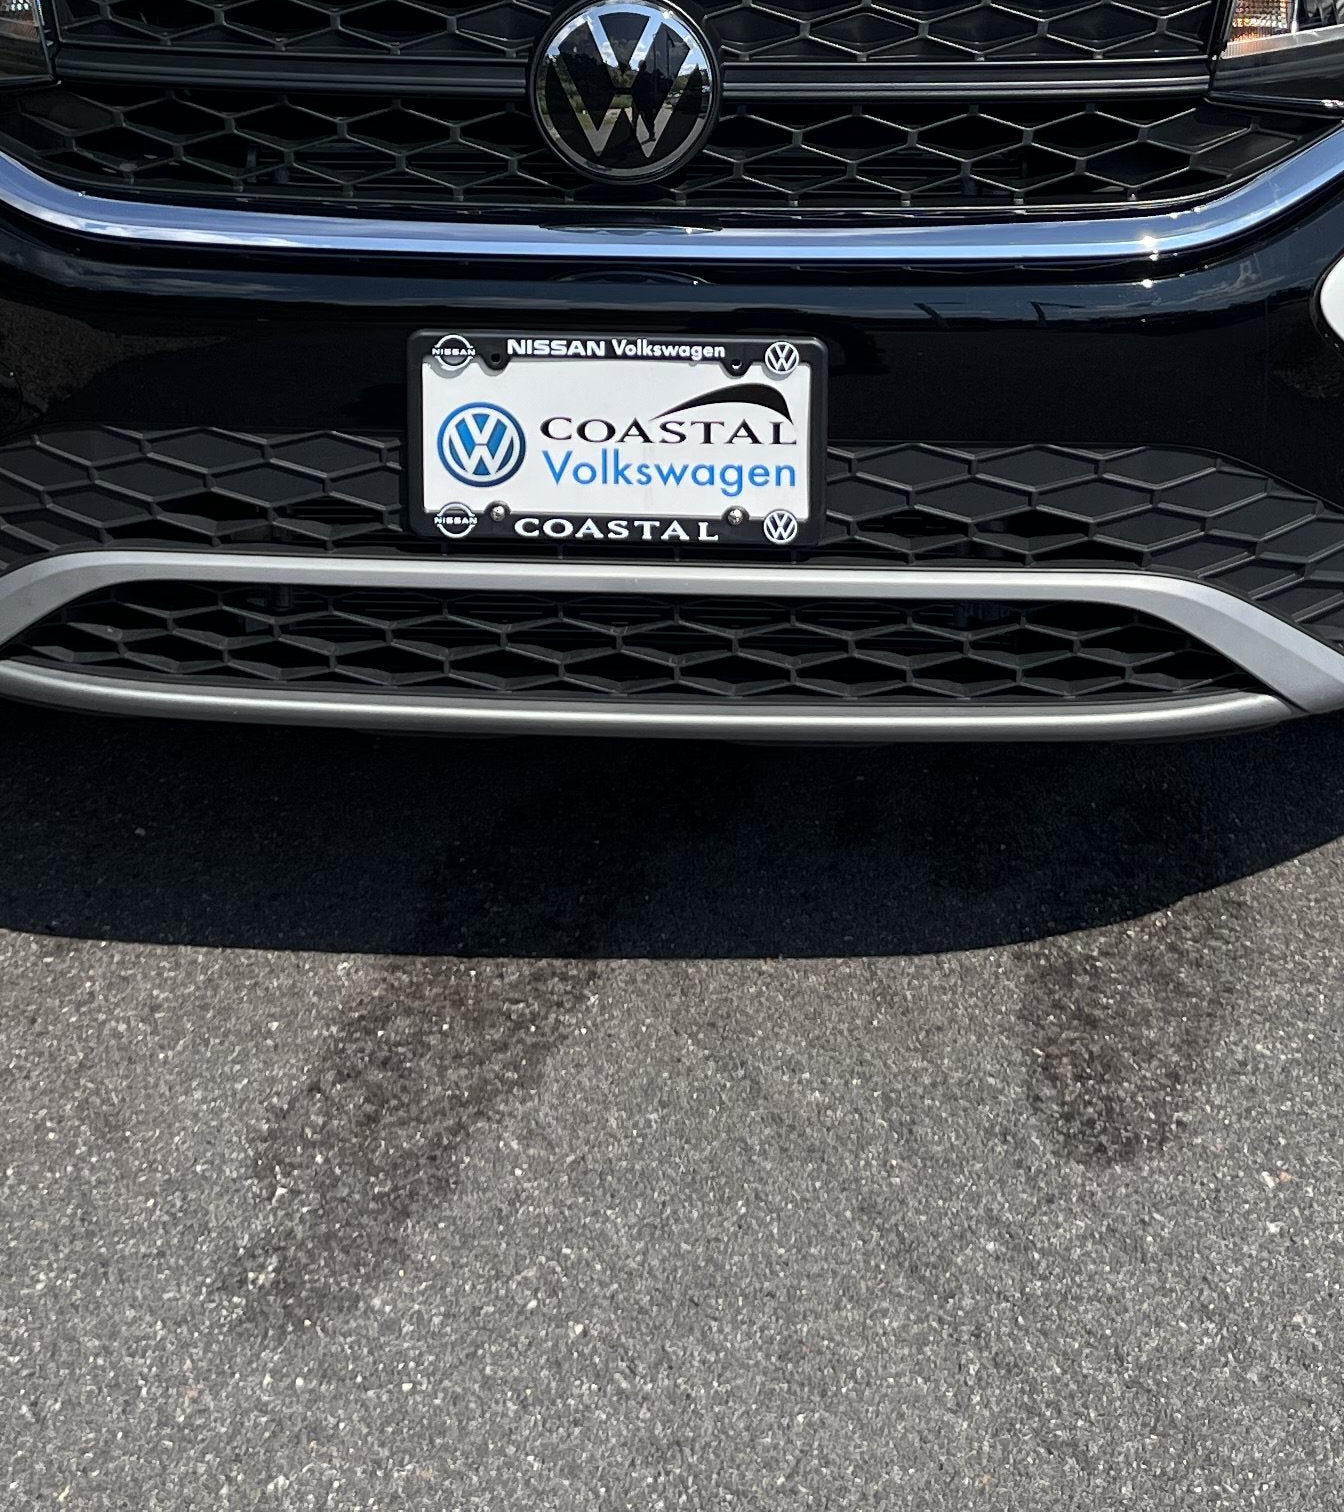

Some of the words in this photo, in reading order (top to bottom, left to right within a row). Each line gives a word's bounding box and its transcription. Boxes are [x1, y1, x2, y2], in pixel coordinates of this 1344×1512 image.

[432, 347, 476, 356] NISSAN
[507, 338, 606, 356] NISSAN
[611, 338, 726, 360] Volkswagen
[539, 416, 797, 445] COASTAL
[541, 448, 796, 497] Volkswagen
[434, 516, 478, 525] NISSAN
[514, 517, 719, 542] COASTAL
